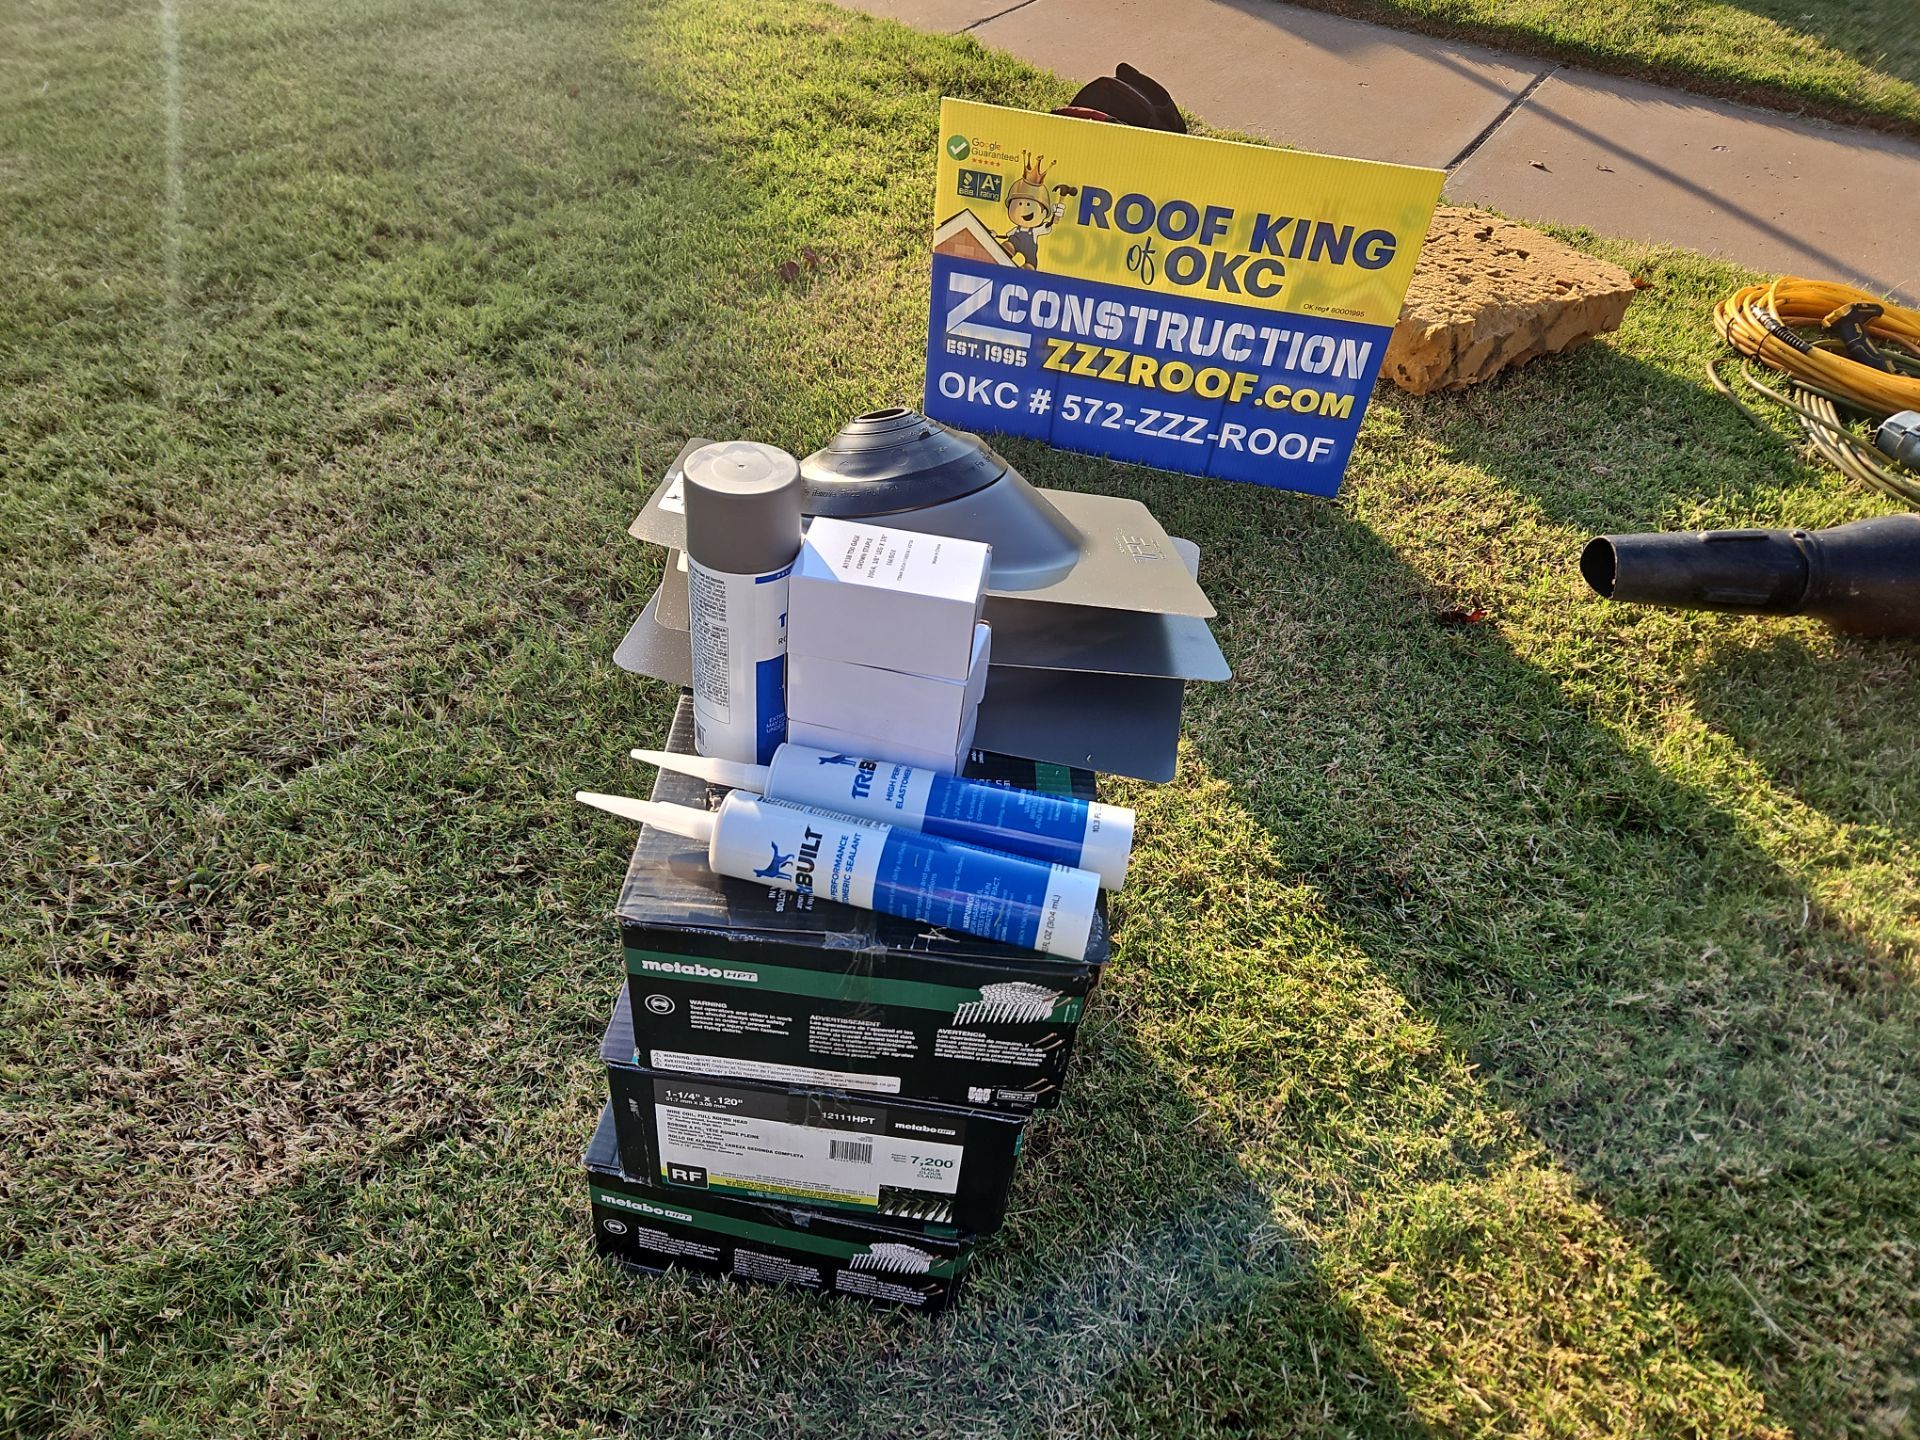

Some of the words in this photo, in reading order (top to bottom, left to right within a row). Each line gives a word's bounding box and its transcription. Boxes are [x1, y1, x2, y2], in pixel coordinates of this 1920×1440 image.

[971, 147, 1020, 163] Guaranteed
[981, 174, 1000, 191] A+
[980, 190, 1000, 200] rating
[1077, 185, 1234, 246] ROOF
[1249, 213, 1397, 270] KING
[1126, 236, 1155, 285] of
[1164, 246, 1286, 298] OKC
[946, 272, 1032, 348] Z
[999, 284, 1373, 380] CONSTRUCTION
[946, 339, 980, 359] EST.
[984, 344, 1027, 367] 1995
[1042, 338, 1355, 419] ZZZROOF.COM
[938, 372, 1019, 409] OKC
[1029, 388, 1051, 415] #
[1061, 394, 1335, 463] 572-ZZZ-ROOF
[856, 553, 867, 570] CROWN
[862, 538, 873, 553] STAPLE
[851, 760, 878, 799] TRIB
[885, 781, 895, 802] HIGH
[892, 763, 902, 780] PERF
[796, 823, 823, 895] RIBUILT
[845, 832, 862, 873] SEALANT
[830, 834, 849, 896] PERFORMANCE
[841, 874, 852, 904] OMERIC
[1052, 894, 1062, 911] mL)
[1047, 910, 1057, 930] (304
[1044, 928, 1053, 940] OZ
[641, 960, 723, 978] metabo
[723, 969, 759, 983] HPT
[690, 999, 727, 1008] WARNING
[810, 1015, 880, 1027] ADVERTISSEMENT
[937, 1029, 986, 1038] AVERTENCIA
[666, 1089, 700, 1101] 1-1/4"
[714, 1096, 743, 1107] .120"
[822, 1112, 875, 1125] 12111HPT
[895, 1122, 937, 1133] metabo
[775, 1150, 803, 1158] COMPLETA
[910, 1155, 953, 1170] 7,200
[672, 1168, 702, 1182] RF
[601, 1194, 664, 1215] metabo
